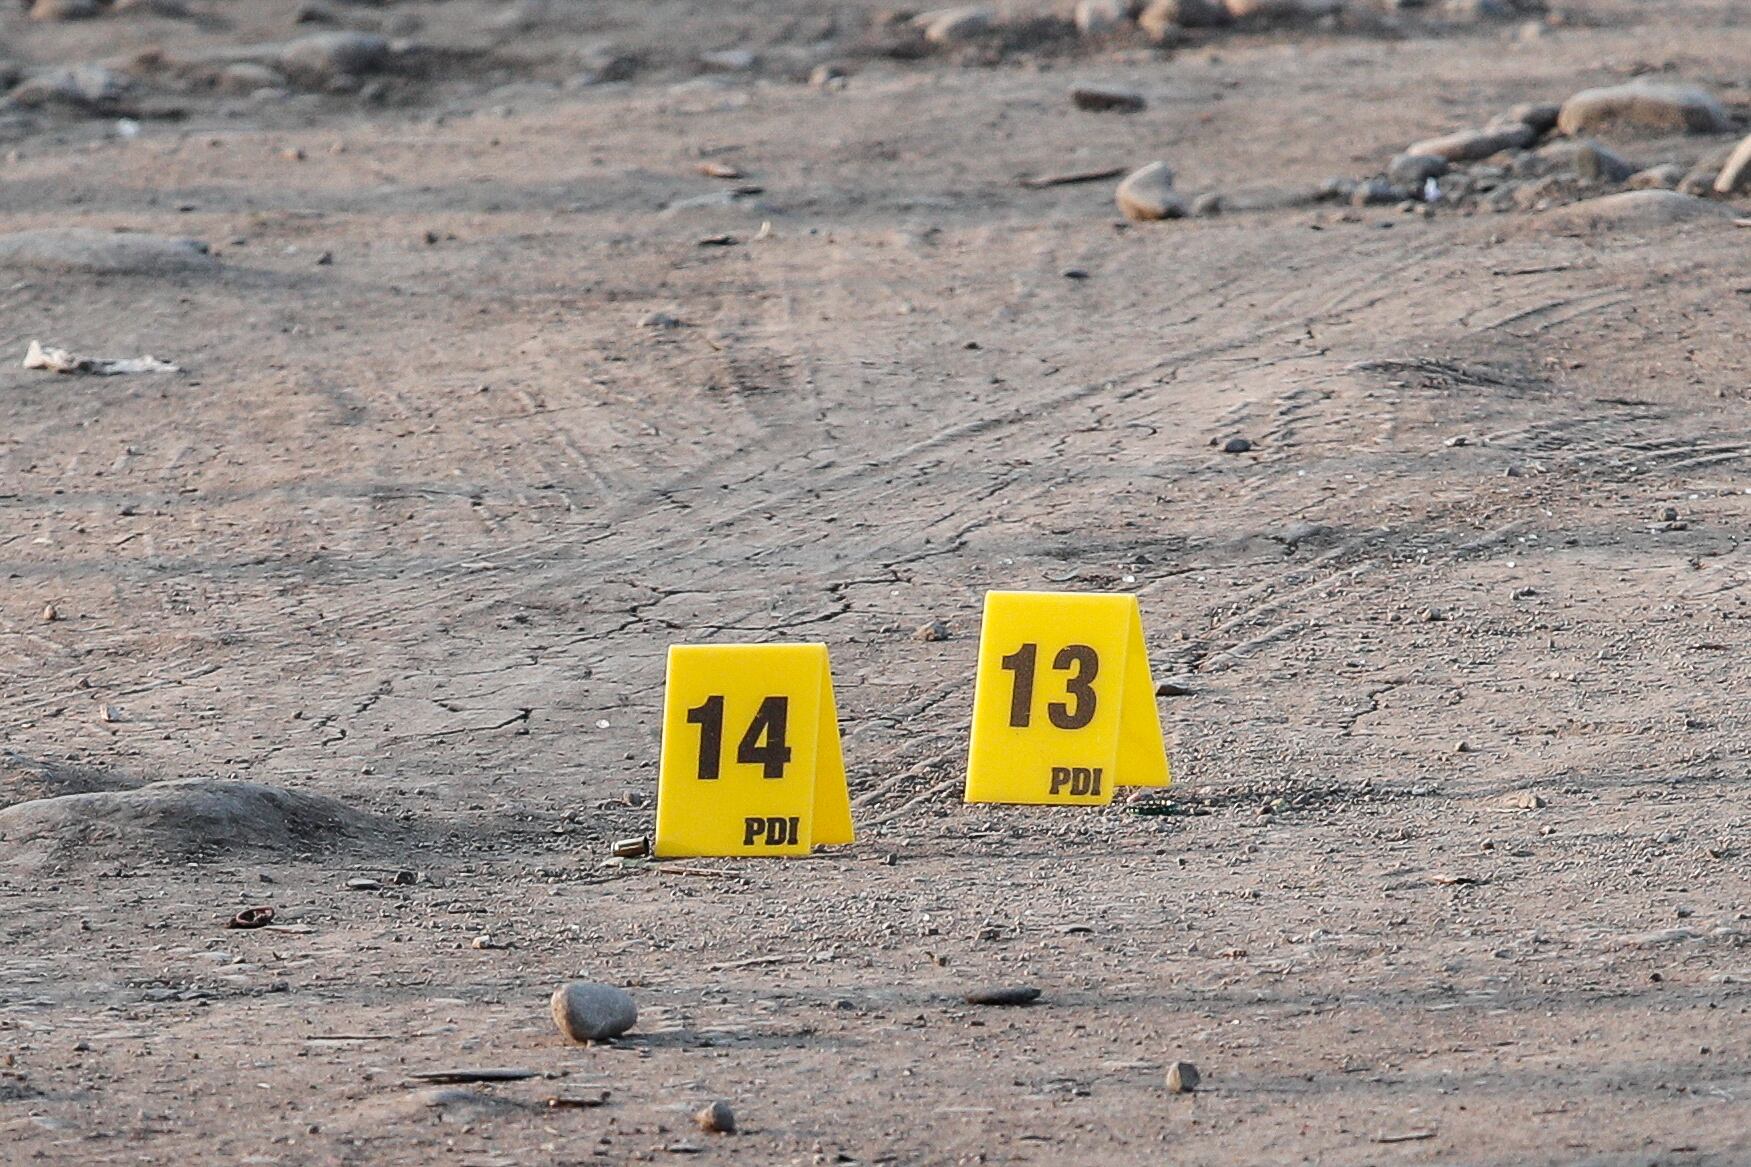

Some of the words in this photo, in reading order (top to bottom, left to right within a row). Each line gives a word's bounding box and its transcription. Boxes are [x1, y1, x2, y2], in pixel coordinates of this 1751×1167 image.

[1002, 643, 1099, 730] 13
[686, 695, 791, 780] 14
[1049, 767, 1103, 797] PDI
[743, 817, 799, 846] PDI
